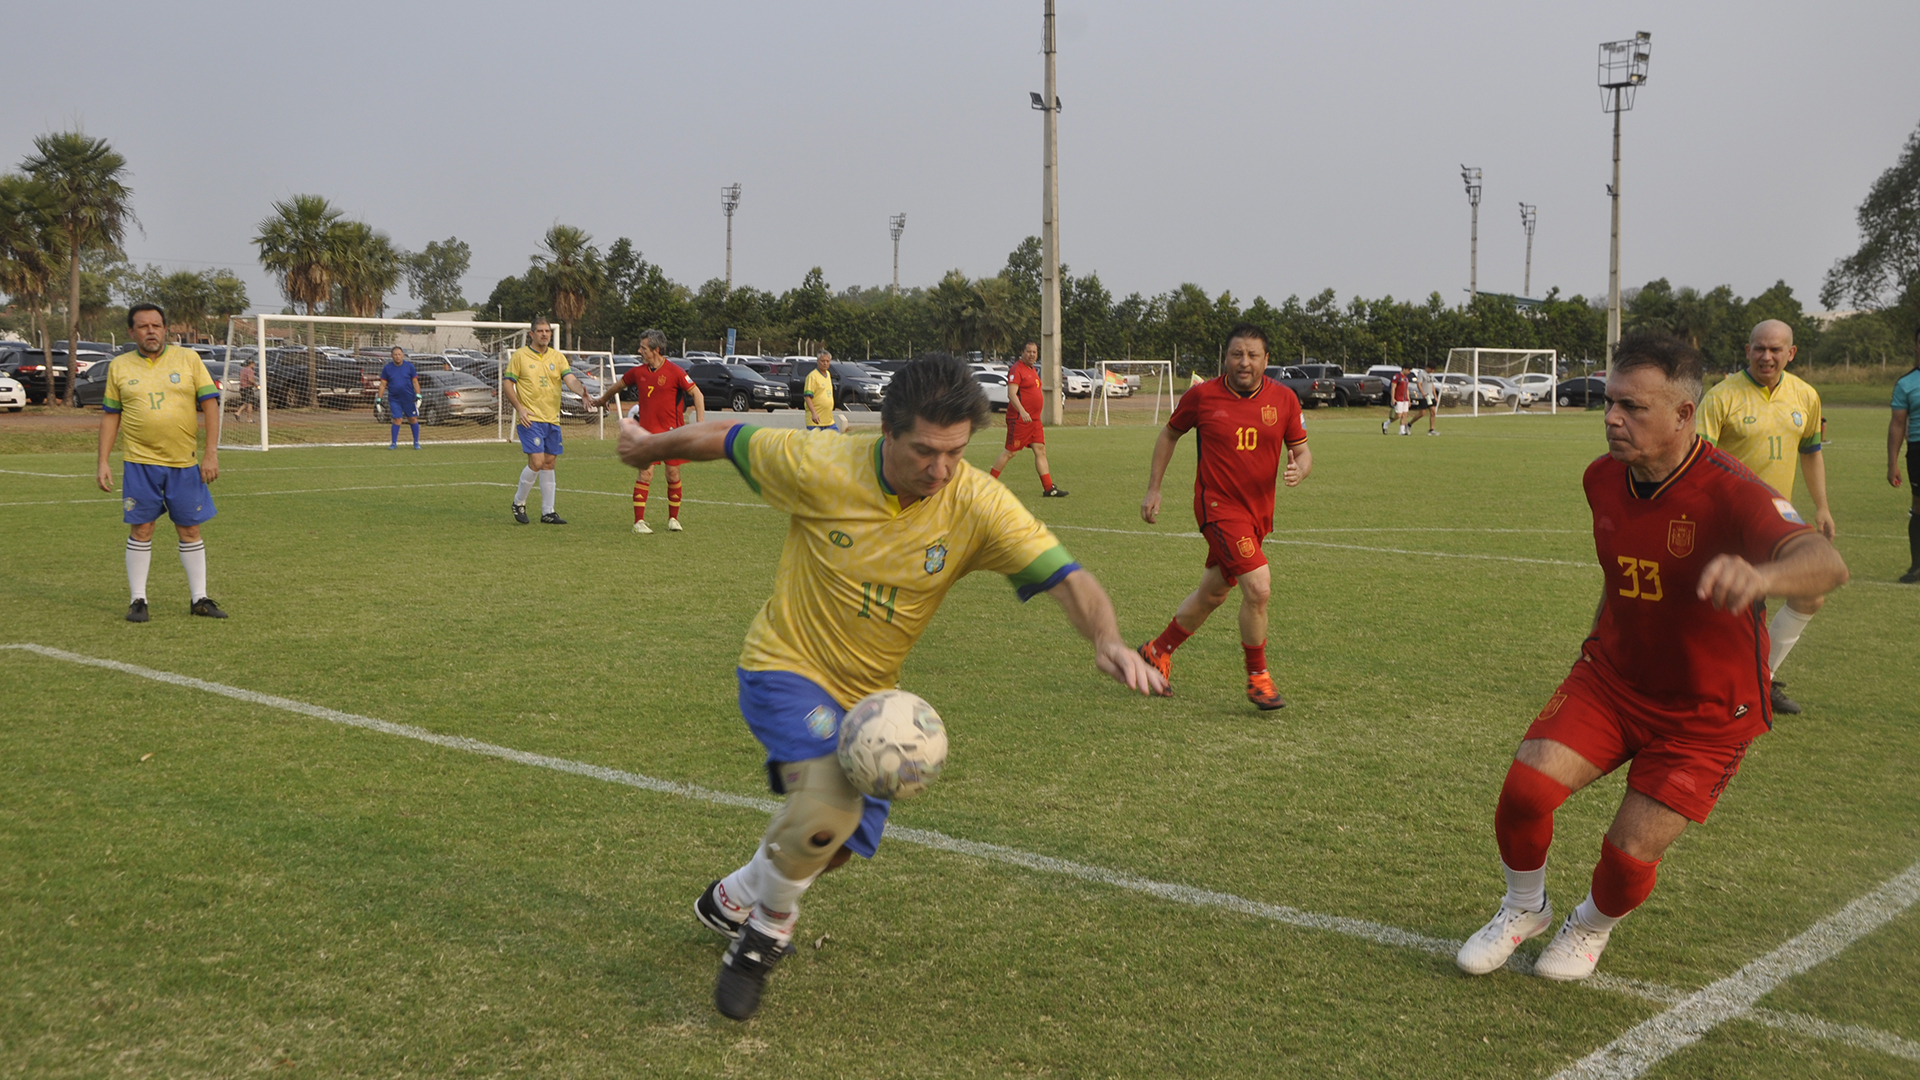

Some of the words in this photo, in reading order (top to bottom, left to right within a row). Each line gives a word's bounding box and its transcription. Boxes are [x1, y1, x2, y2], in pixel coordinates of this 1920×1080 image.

[148, 391, 165, 410] 17
[647, 385, 654, 398] 7
[1235, 427, 1258, 451] 10
[1768, 435, 1782, 460] 11
[1617, 555, 1663, 601] 33
[857, 582, 898, 623] 14
